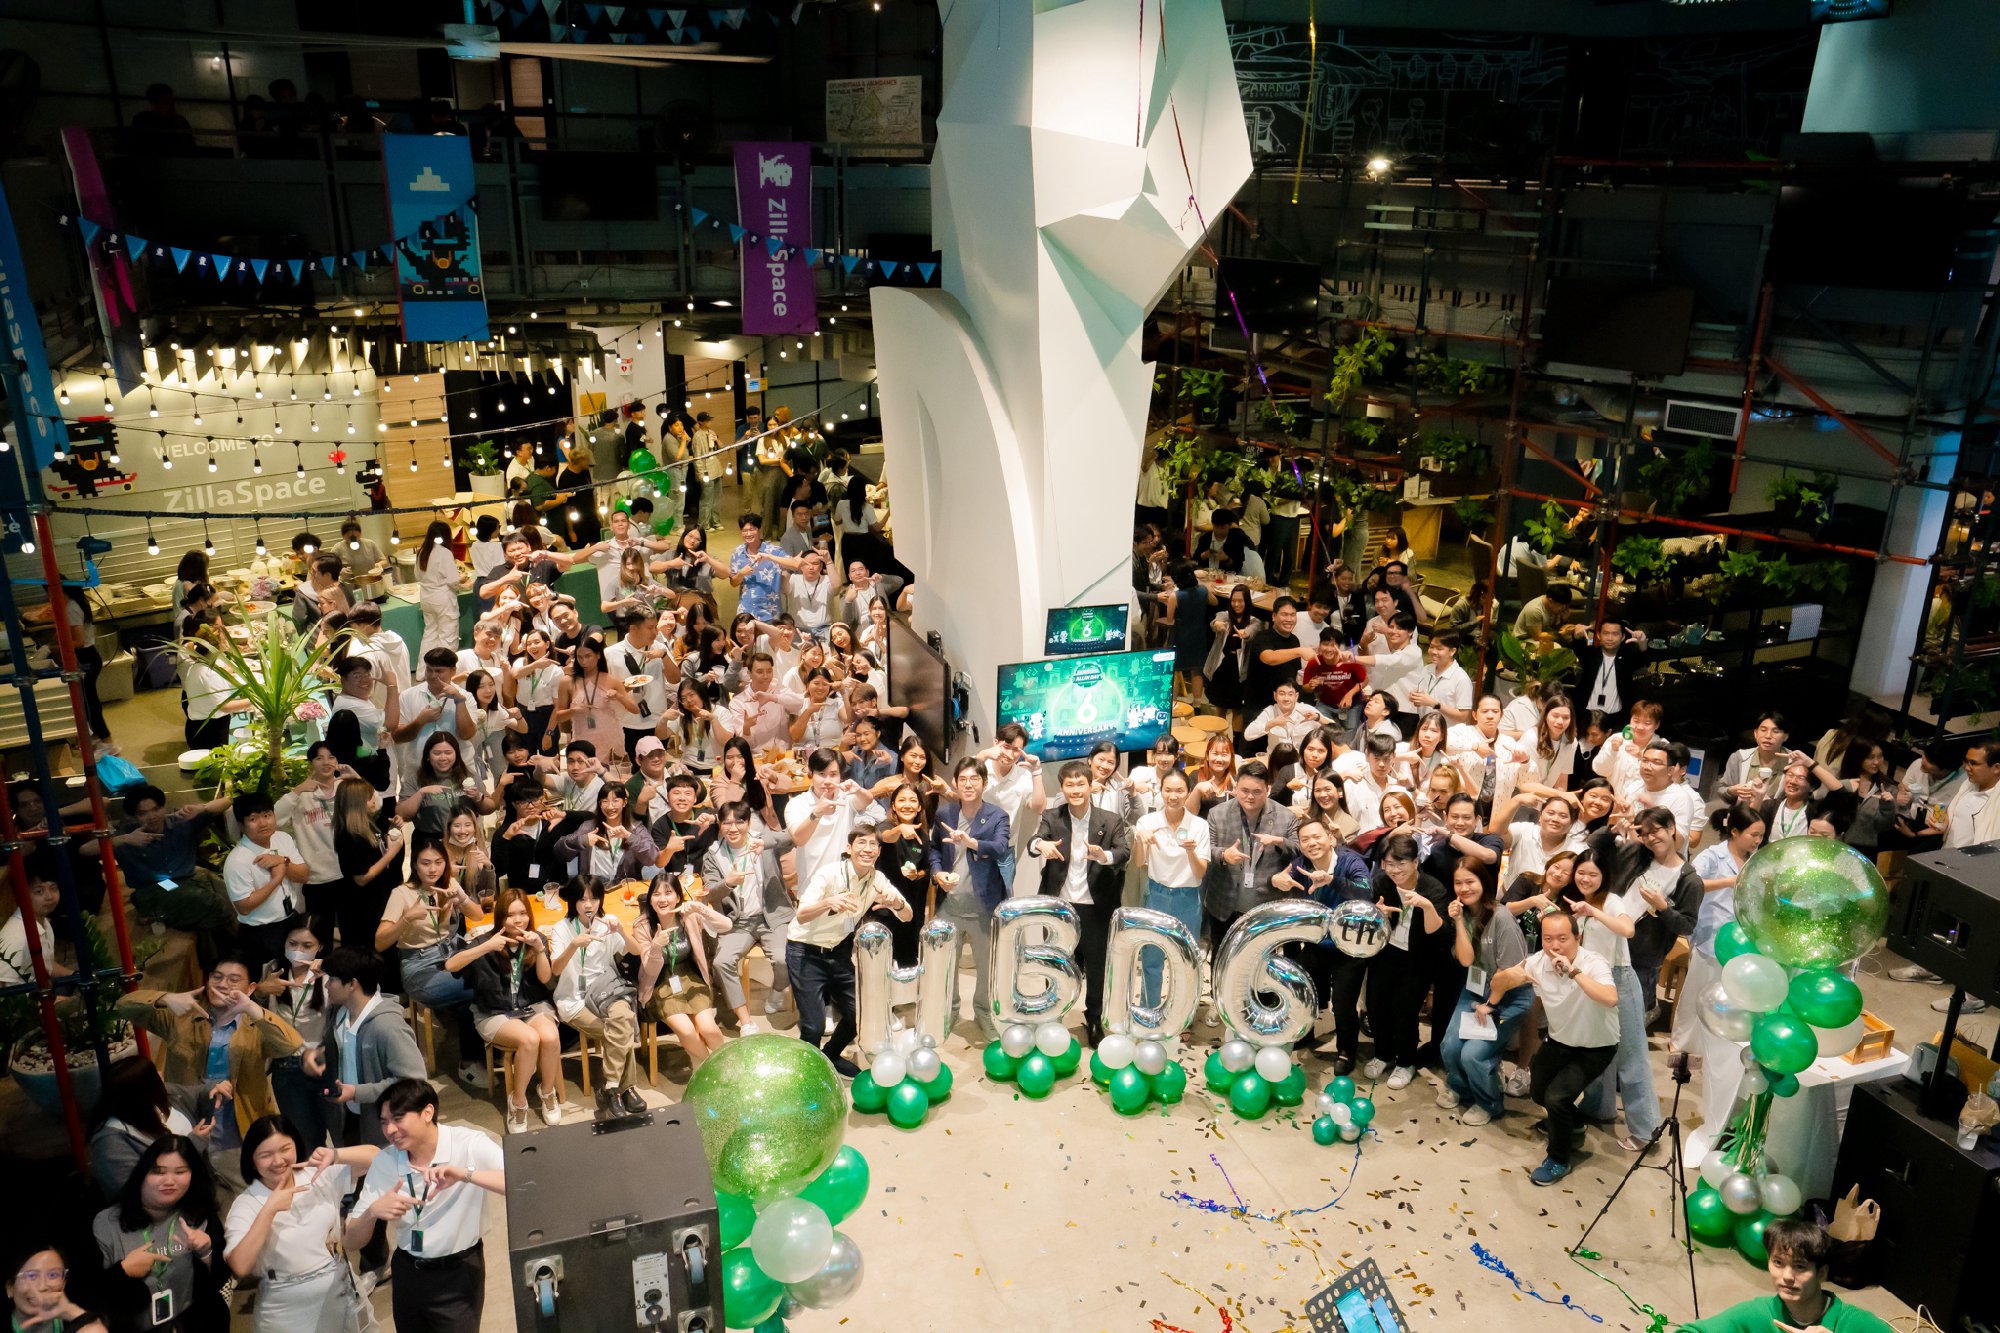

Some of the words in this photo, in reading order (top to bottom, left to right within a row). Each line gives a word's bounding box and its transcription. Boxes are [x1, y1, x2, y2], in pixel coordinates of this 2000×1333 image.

[1251, 82, 1300, 92] ANANDA
[767, 198, 788, 317] ZillSpace
[153, 437, 247, 460] WELCOME
[163, 476, 327, 513] ZillaSpace
[1077, 693, 1098, 724] 6
[1057, 723, 1115, 736] ANNIVERSARY
